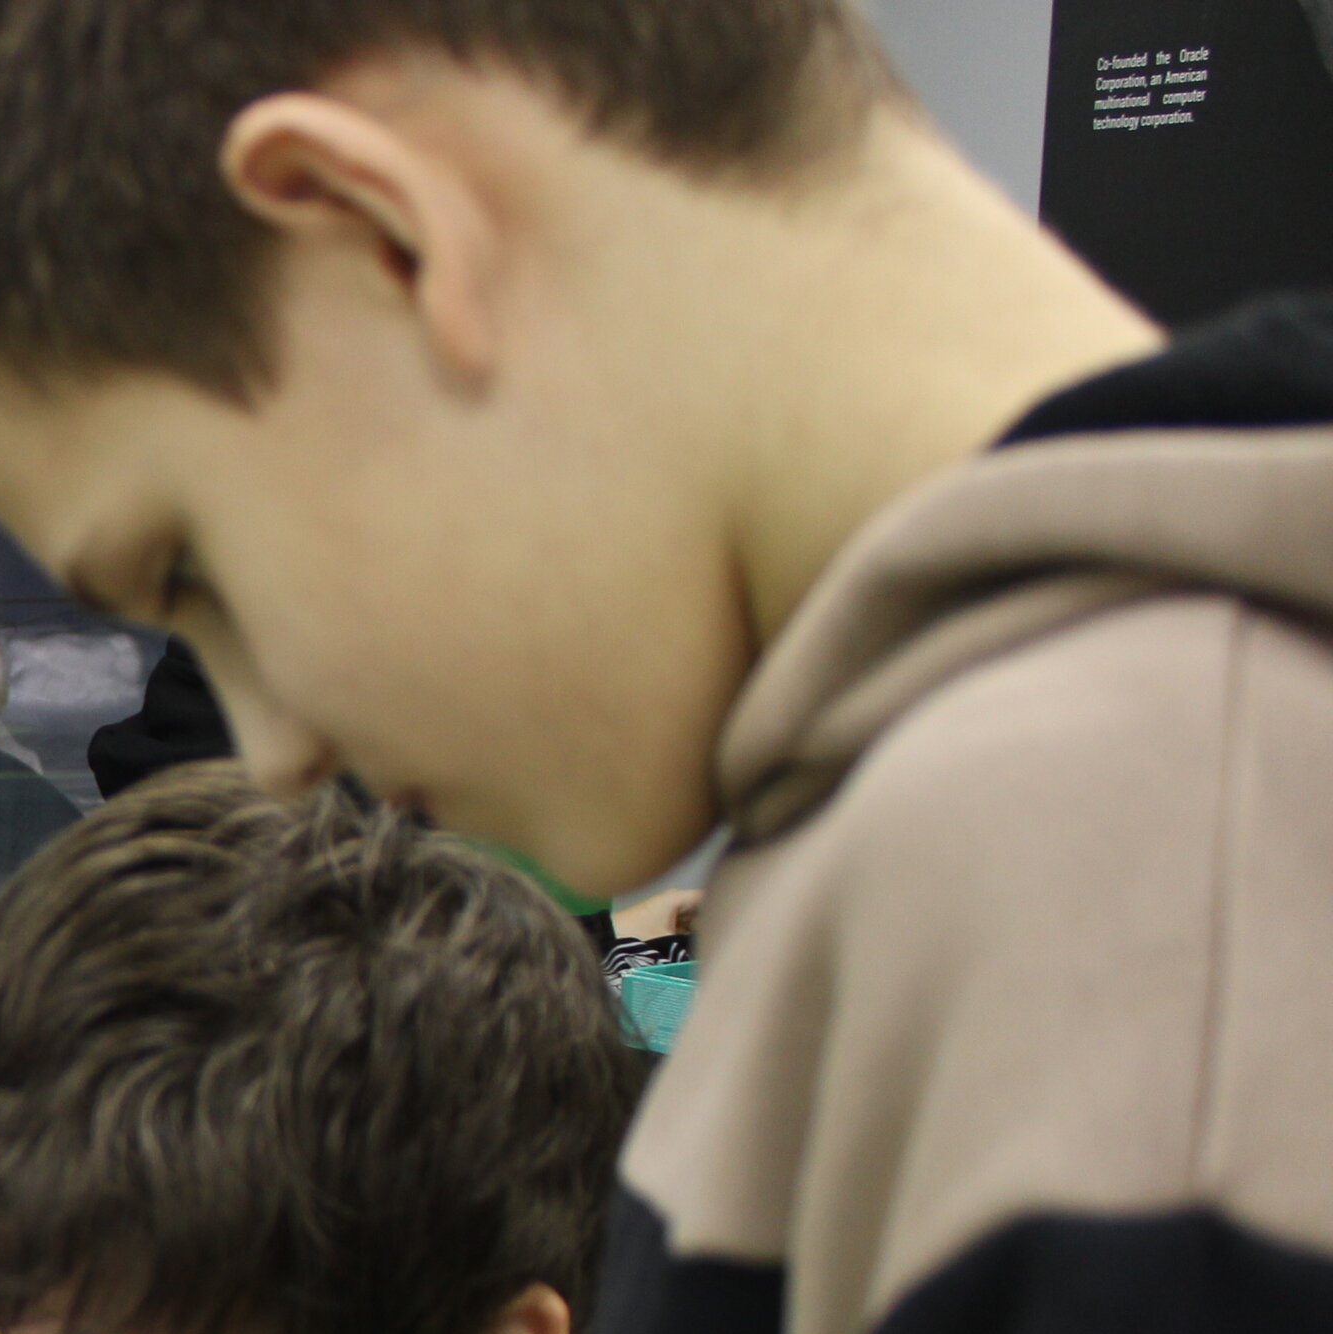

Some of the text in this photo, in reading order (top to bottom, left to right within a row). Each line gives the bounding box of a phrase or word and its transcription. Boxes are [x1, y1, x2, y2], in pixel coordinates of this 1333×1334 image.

[1096, 46, 1210, 71] Co-founded the Oracle
[1095, 67, 1208, 93] Corporation, an American
[1094, 89, 1206, 111] multinational computer
[1093, 109, 1194, 130] technology corporation.
